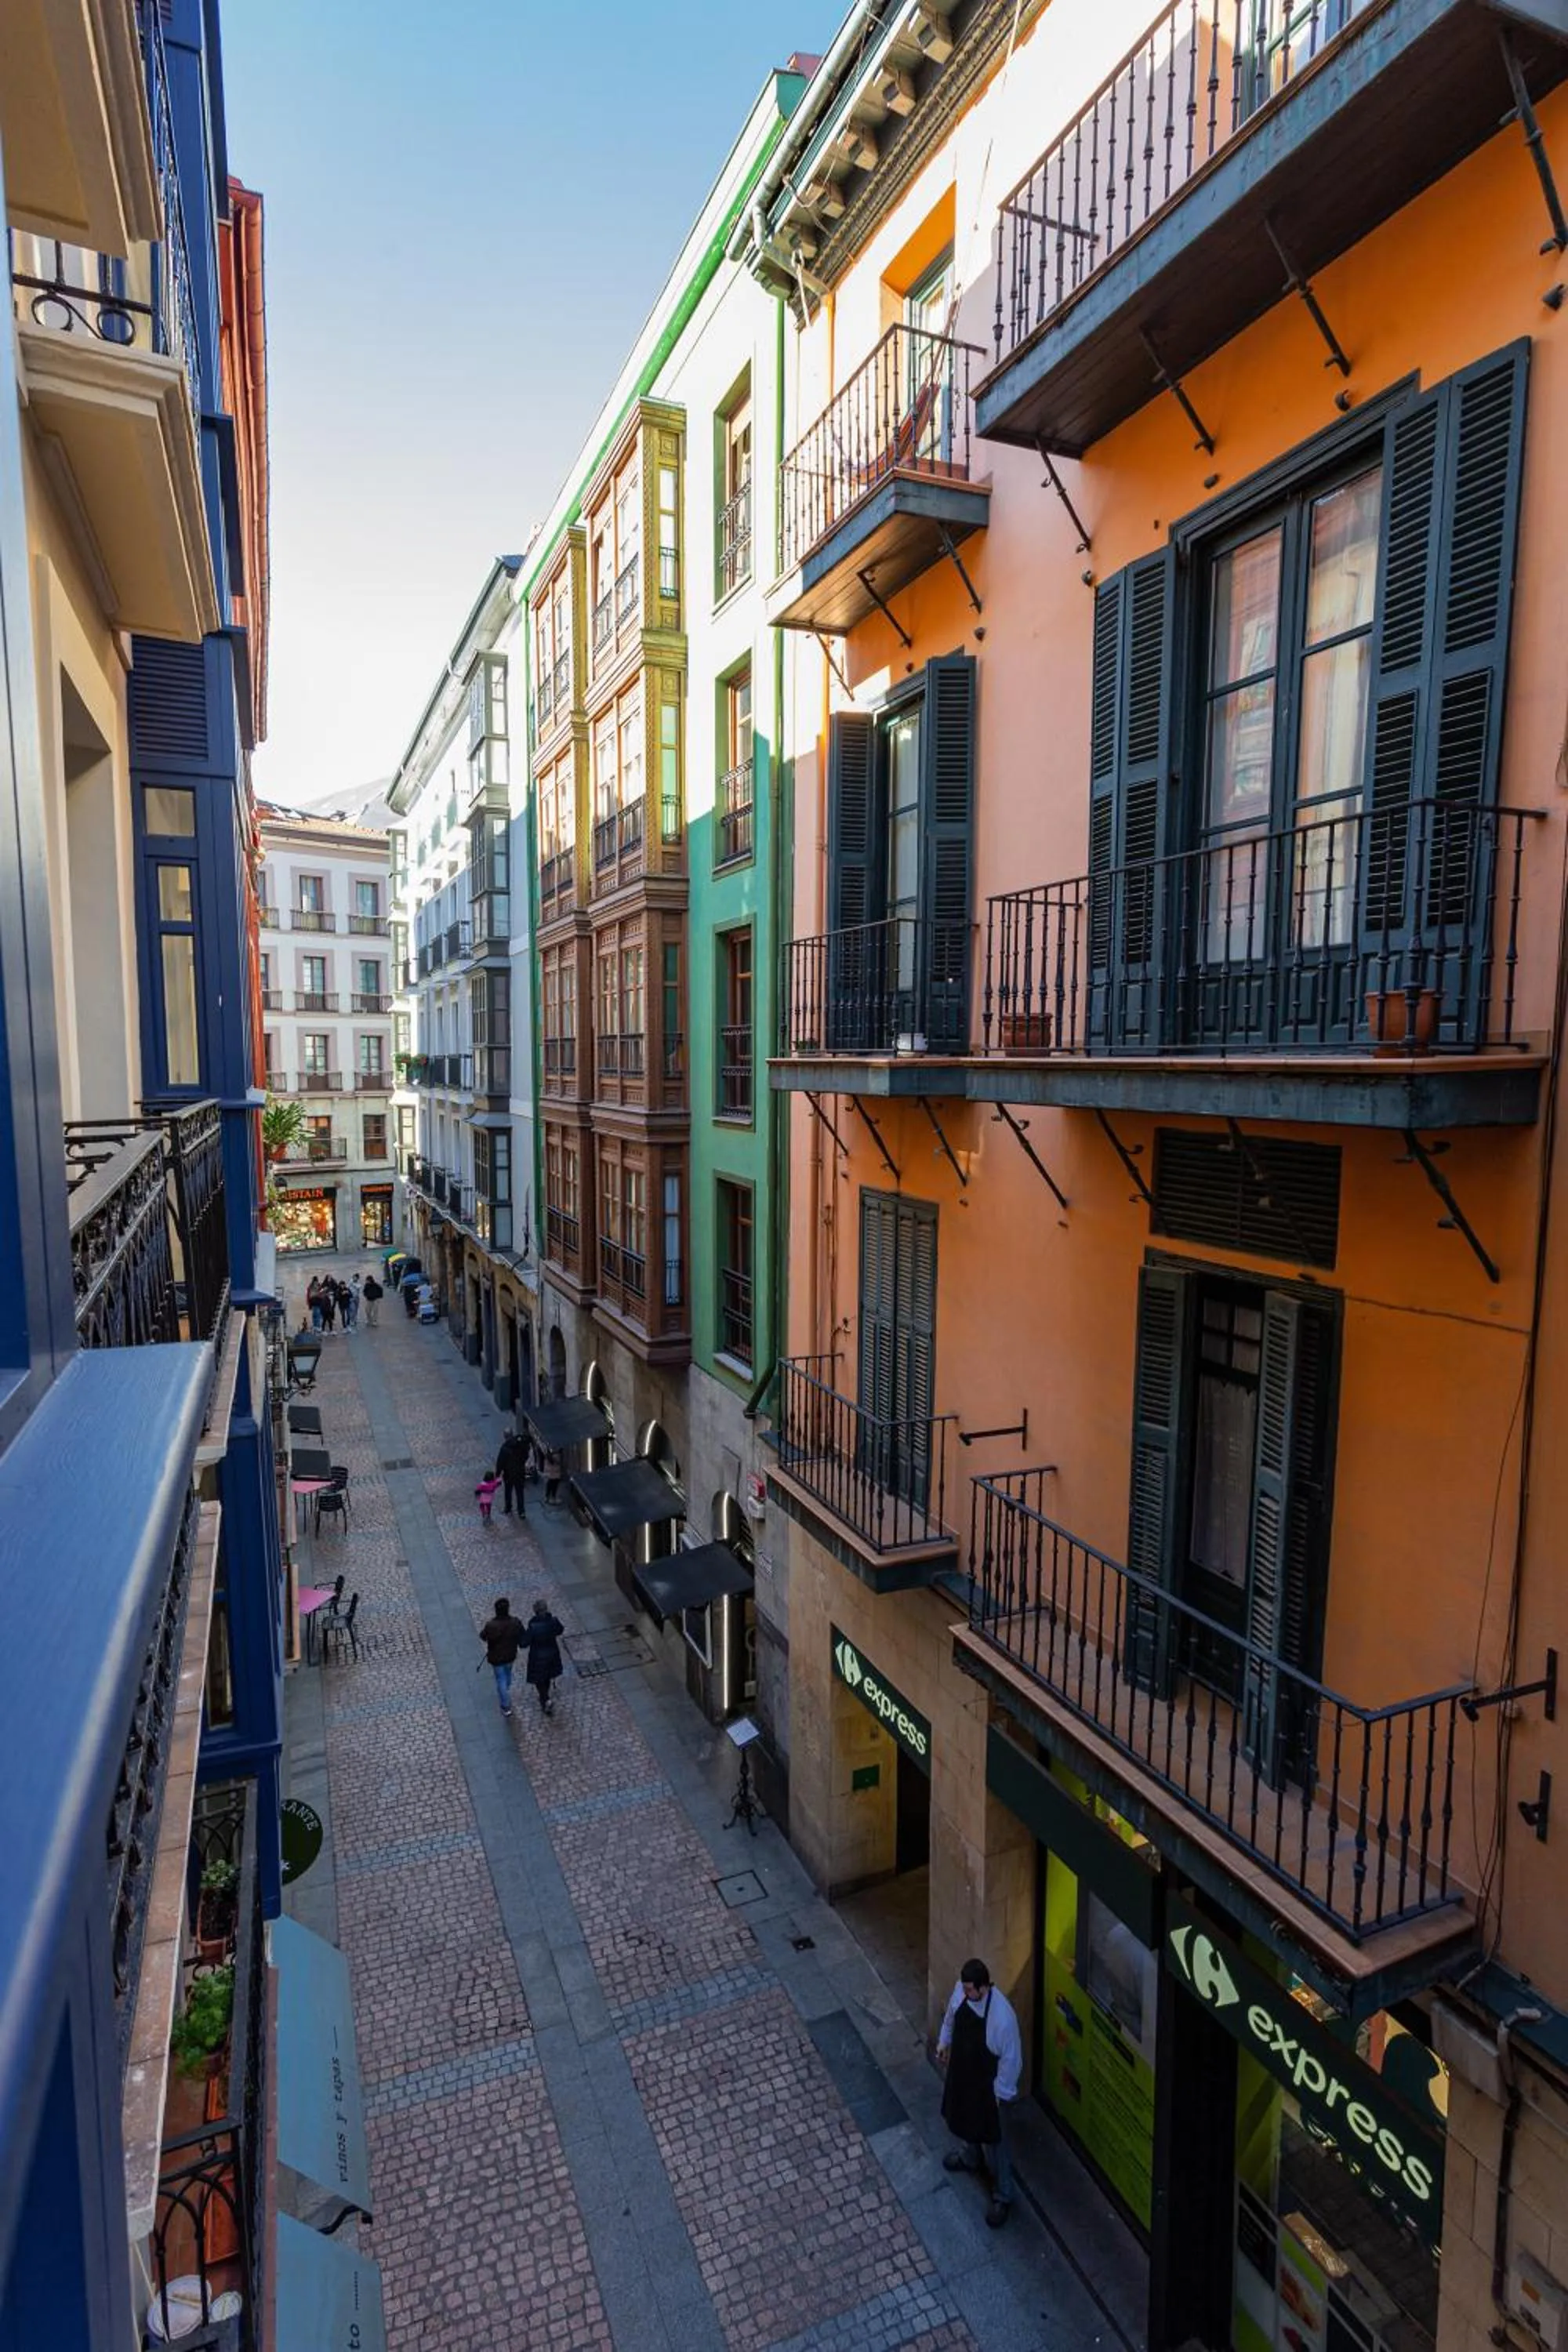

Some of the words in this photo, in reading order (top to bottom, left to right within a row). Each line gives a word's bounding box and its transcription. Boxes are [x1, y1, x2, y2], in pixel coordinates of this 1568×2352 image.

[863, 1675, 927, 1755] express
[331, 2056, 343, 2102] tapas
[1247, 2005, 1433, 2201] express
[335, 2111, 347, 2125] y
[336, 2131, 349, 2183] vinos
